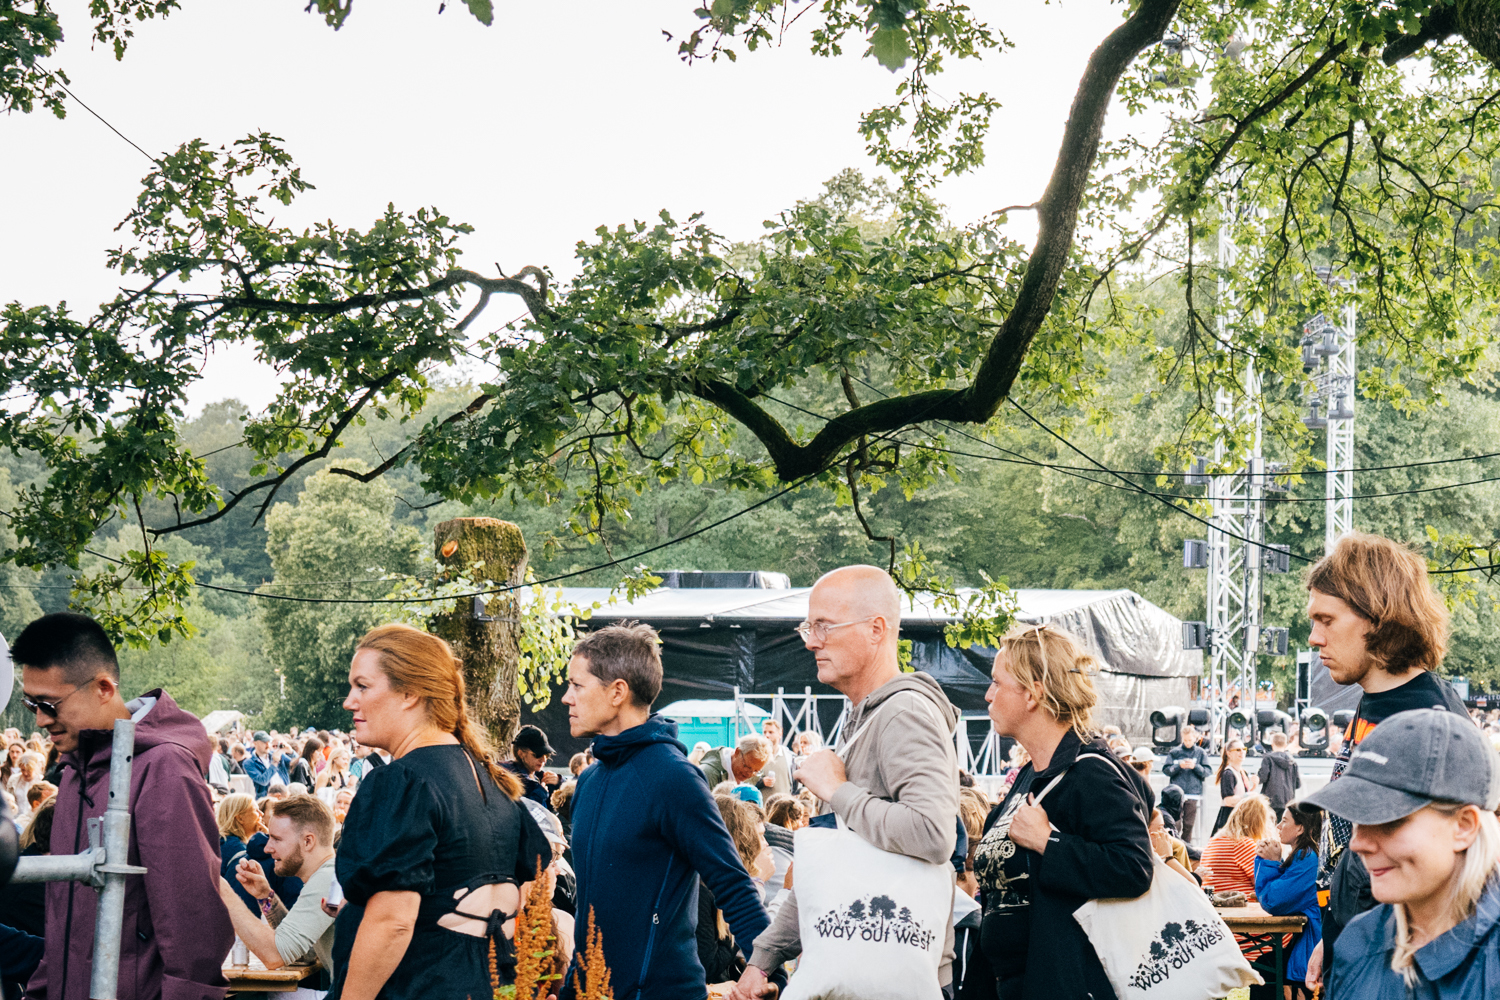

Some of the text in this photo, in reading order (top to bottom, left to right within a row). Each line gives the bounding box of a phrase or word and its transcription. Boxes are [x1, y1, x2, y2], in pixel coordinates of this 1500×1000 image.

[817, 923, 932, 952] way out west
[1135, 927, 1226, 991] way out west
